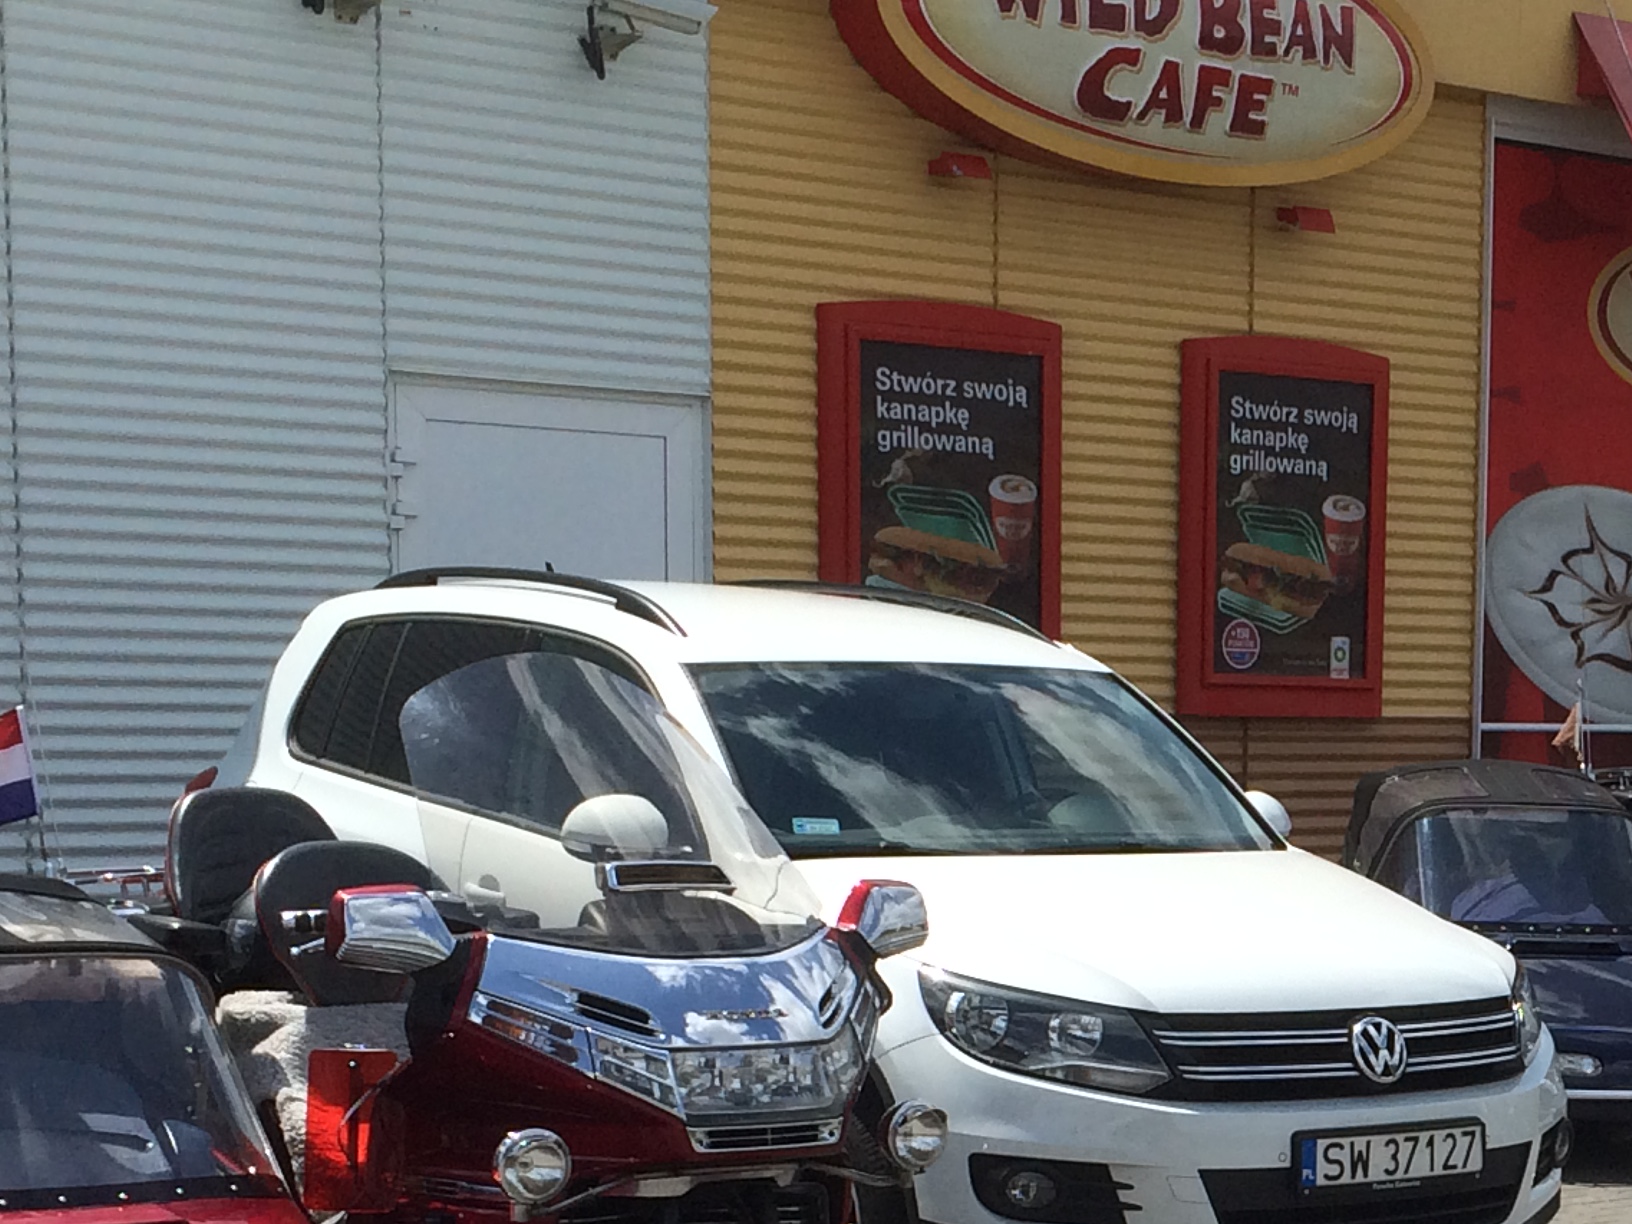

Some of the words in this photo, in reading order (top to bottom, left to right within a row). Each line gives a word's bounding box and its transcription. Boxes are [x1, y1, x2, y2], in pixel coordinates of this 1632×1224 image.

[1197, 0, 1356, 73] BEAN
[1075, 46, 1276, 137] CAFE
[875, 366, 957, 397] Stwórz
[963, 378, 1028, 409] swoją
[876, 395, 970, 431] kanapkę
[1230, 395, 1299, 424] Stwórz
[1303, 405, 1359, 434] swoją
[877, 424, 994, 461] grillowaną
[1230, 421, 1310, 455] kanapkę
[1229, 449, 1329, 482] grillowaną
[1323, 1139, 1372, 1182] SW
[1383, 1130, 1477, 1177] 37127
